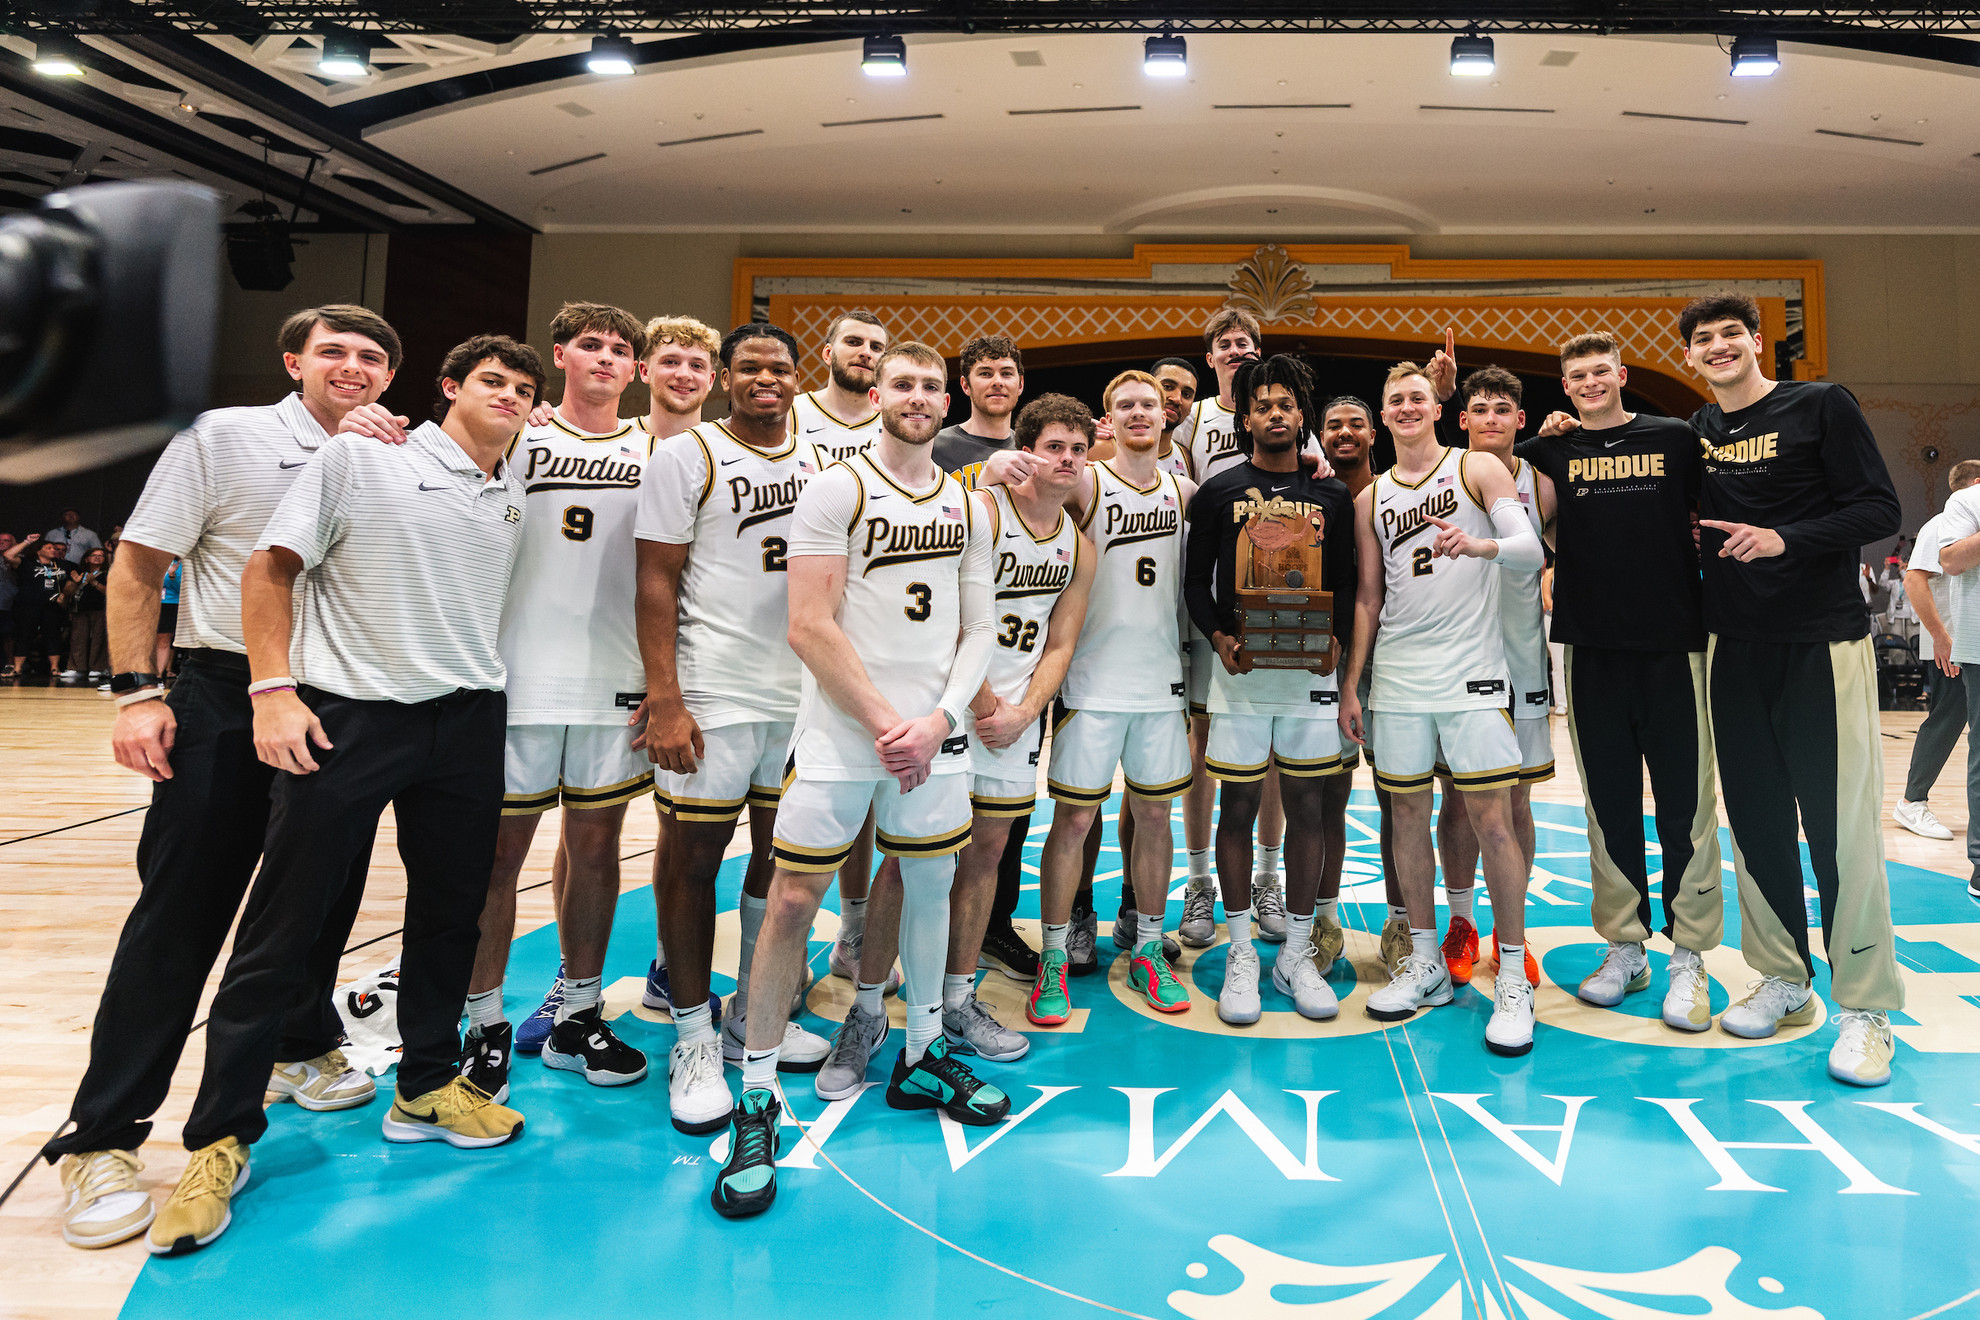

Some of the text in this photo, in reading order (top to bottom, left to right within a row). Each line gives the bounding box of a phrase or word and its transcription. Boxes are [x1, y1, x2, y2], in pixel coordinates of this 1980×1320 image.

[524, 446, 641, 484] Purdue
[1568, 453, 1665, 482] PURDUE
[561, 504, 594, 542] 9
[1105, 503, 1177, 537] Purdue
[1380, 488, 1457, 540] Purdue
[862, 517, 965, 558] Purdue
[994, 551, 1069, 588] Purdue
[1135, 556, 1157, 587] 6
[1412, 546, 1433, 577] 2
[904, 582, 932, 622] 3
[997, 613, 1039, 652] 32
[672, 1154, 702, 1166] TM
